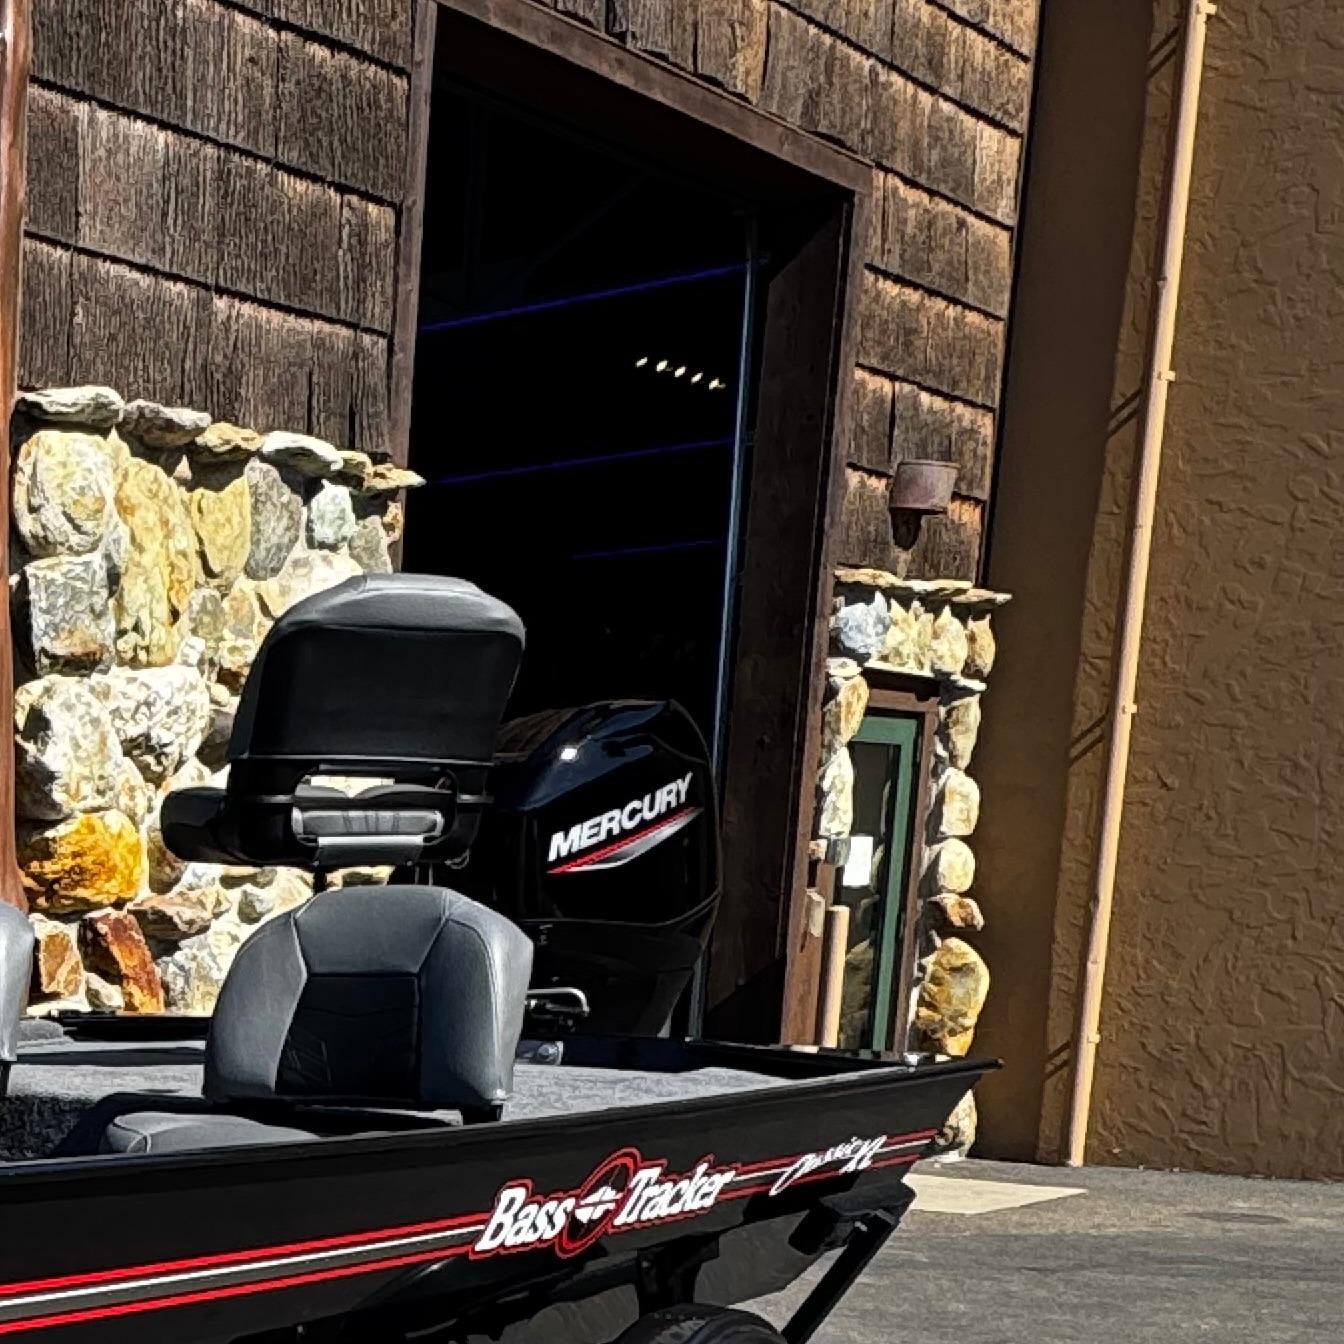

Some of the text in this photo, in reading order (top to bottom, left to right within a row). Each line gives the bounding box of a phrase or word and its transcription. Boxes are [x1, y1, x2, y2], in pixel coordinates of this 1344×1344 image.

[547, 770, 694, 862] MERCURY
[474, 1185, 576, 1252] Bass
[612, 1161, 737, 1226] Tracker
